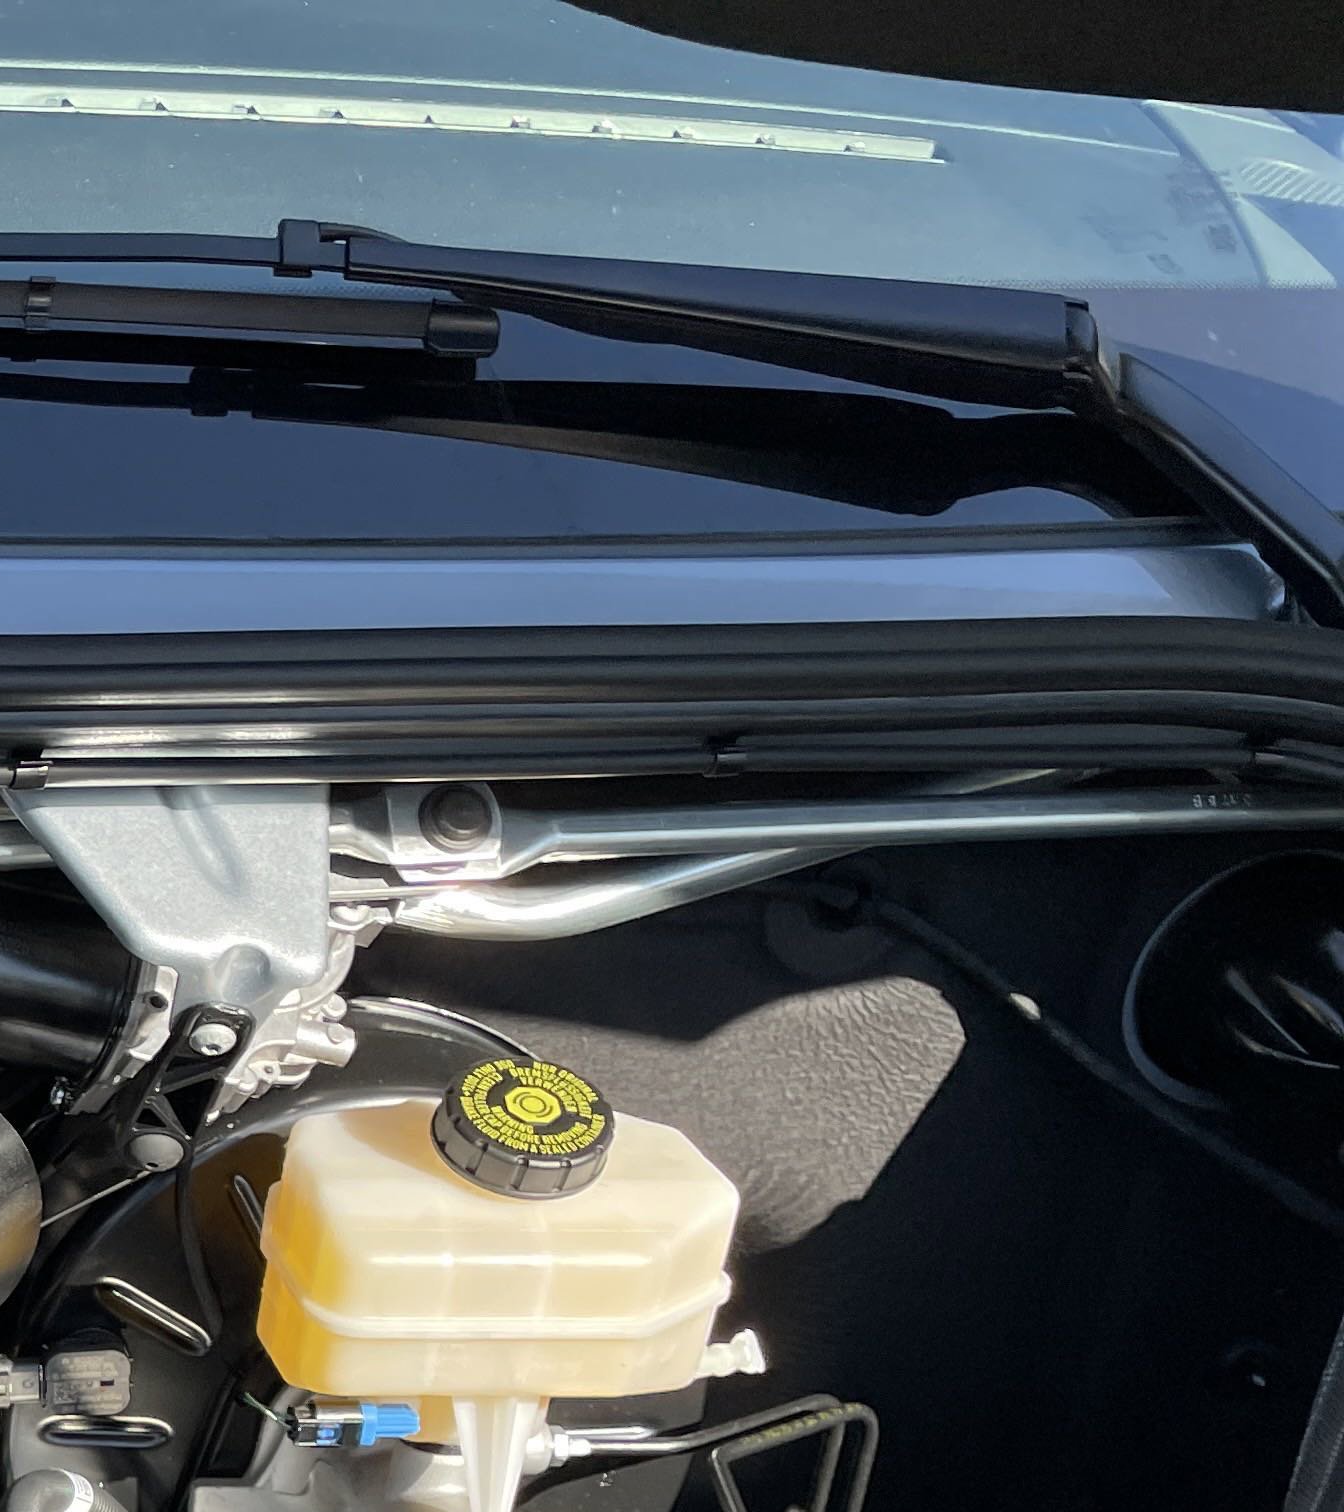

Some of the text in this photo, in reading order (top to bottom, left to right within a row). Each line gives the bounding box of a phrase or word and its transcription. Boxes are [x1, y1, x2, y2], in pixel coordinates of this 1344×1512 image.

[482, 1114, 503, 1127] CAP
[500, 1125, 540, 1145] BEFORE
[542, 1121, 588, 1145] REMOVING
[491, 1105, 534, 1134] WARNING
[473, 1119, 501, 1139] FLUID
[498, 1135, 529, 1151] FROM
[530, 1143, 538, 1153] A
[539, 1142, 577, 1154] SEALED
